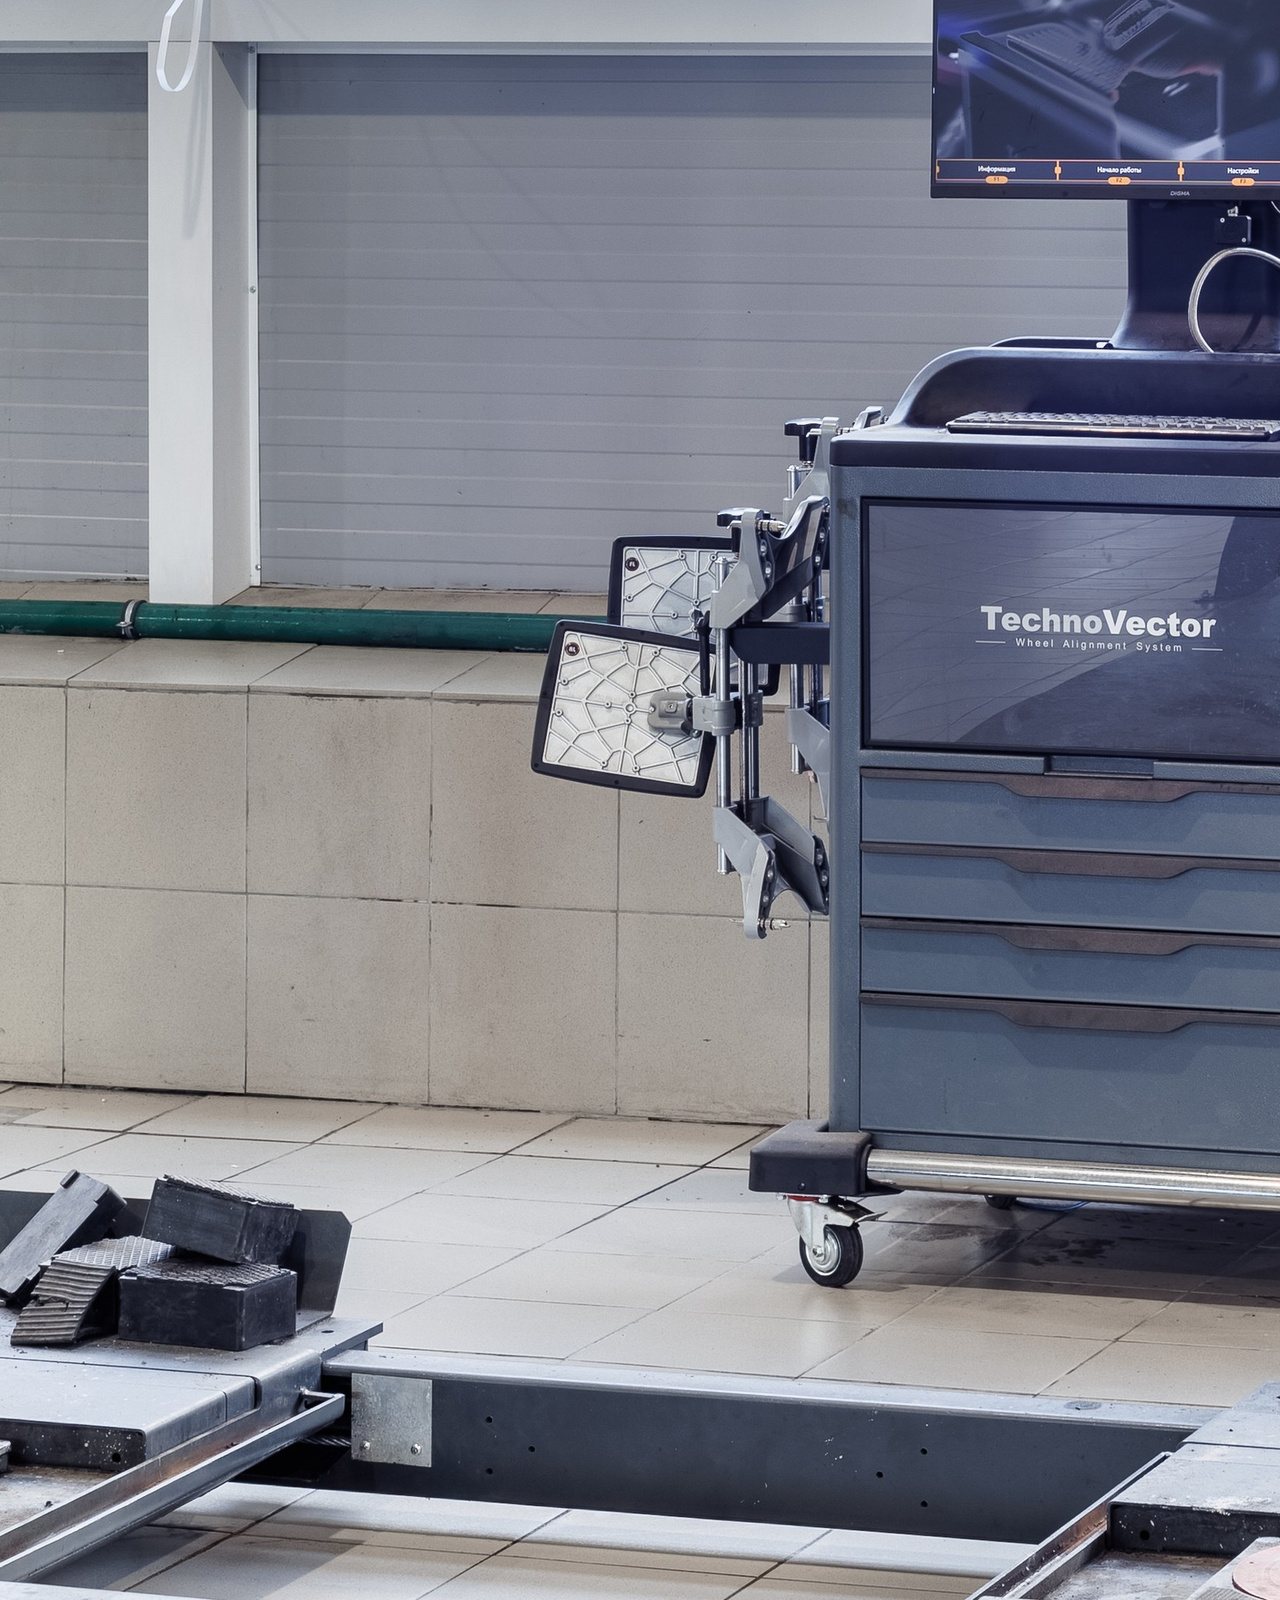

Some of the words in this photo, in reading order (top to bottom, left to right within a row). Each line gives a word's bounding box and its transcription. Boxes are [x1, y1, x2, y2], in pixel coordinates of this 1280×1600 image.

[977, 165, 1016, 174] Информация
[1119, 166, 1142, 174] работы
[1227, 167, 1260, 176] Настройки
[980, 605, 1217, 638] TechnoVector
[1015, 637, 1054, 648] Wheel
[1062, 638, 1127, 651] Alignment
[1136, 641, 1182, 653] System
